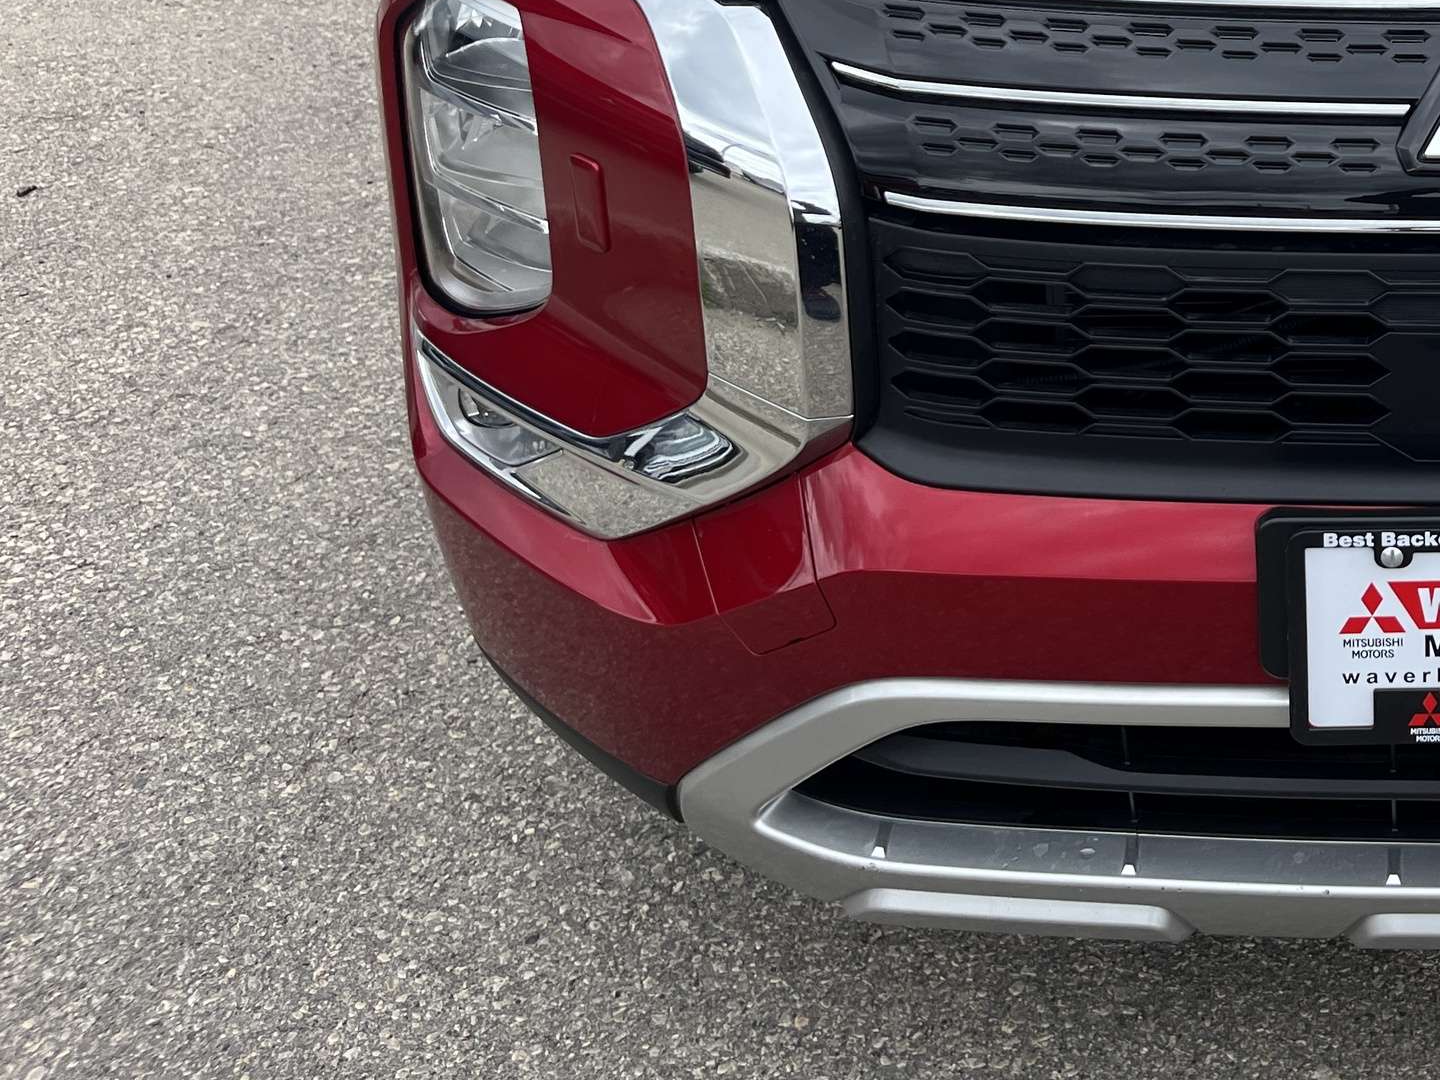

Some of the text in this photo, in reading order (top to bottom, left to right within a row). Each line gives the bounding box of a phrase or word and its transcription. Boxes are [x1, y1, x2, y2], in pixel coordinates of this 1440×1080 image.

[1323, 532, 1375, 548] Best
[1343, 637, 1404, 648] MITSUBISHI
[1351, 648, 1395, 659] MOTORS
